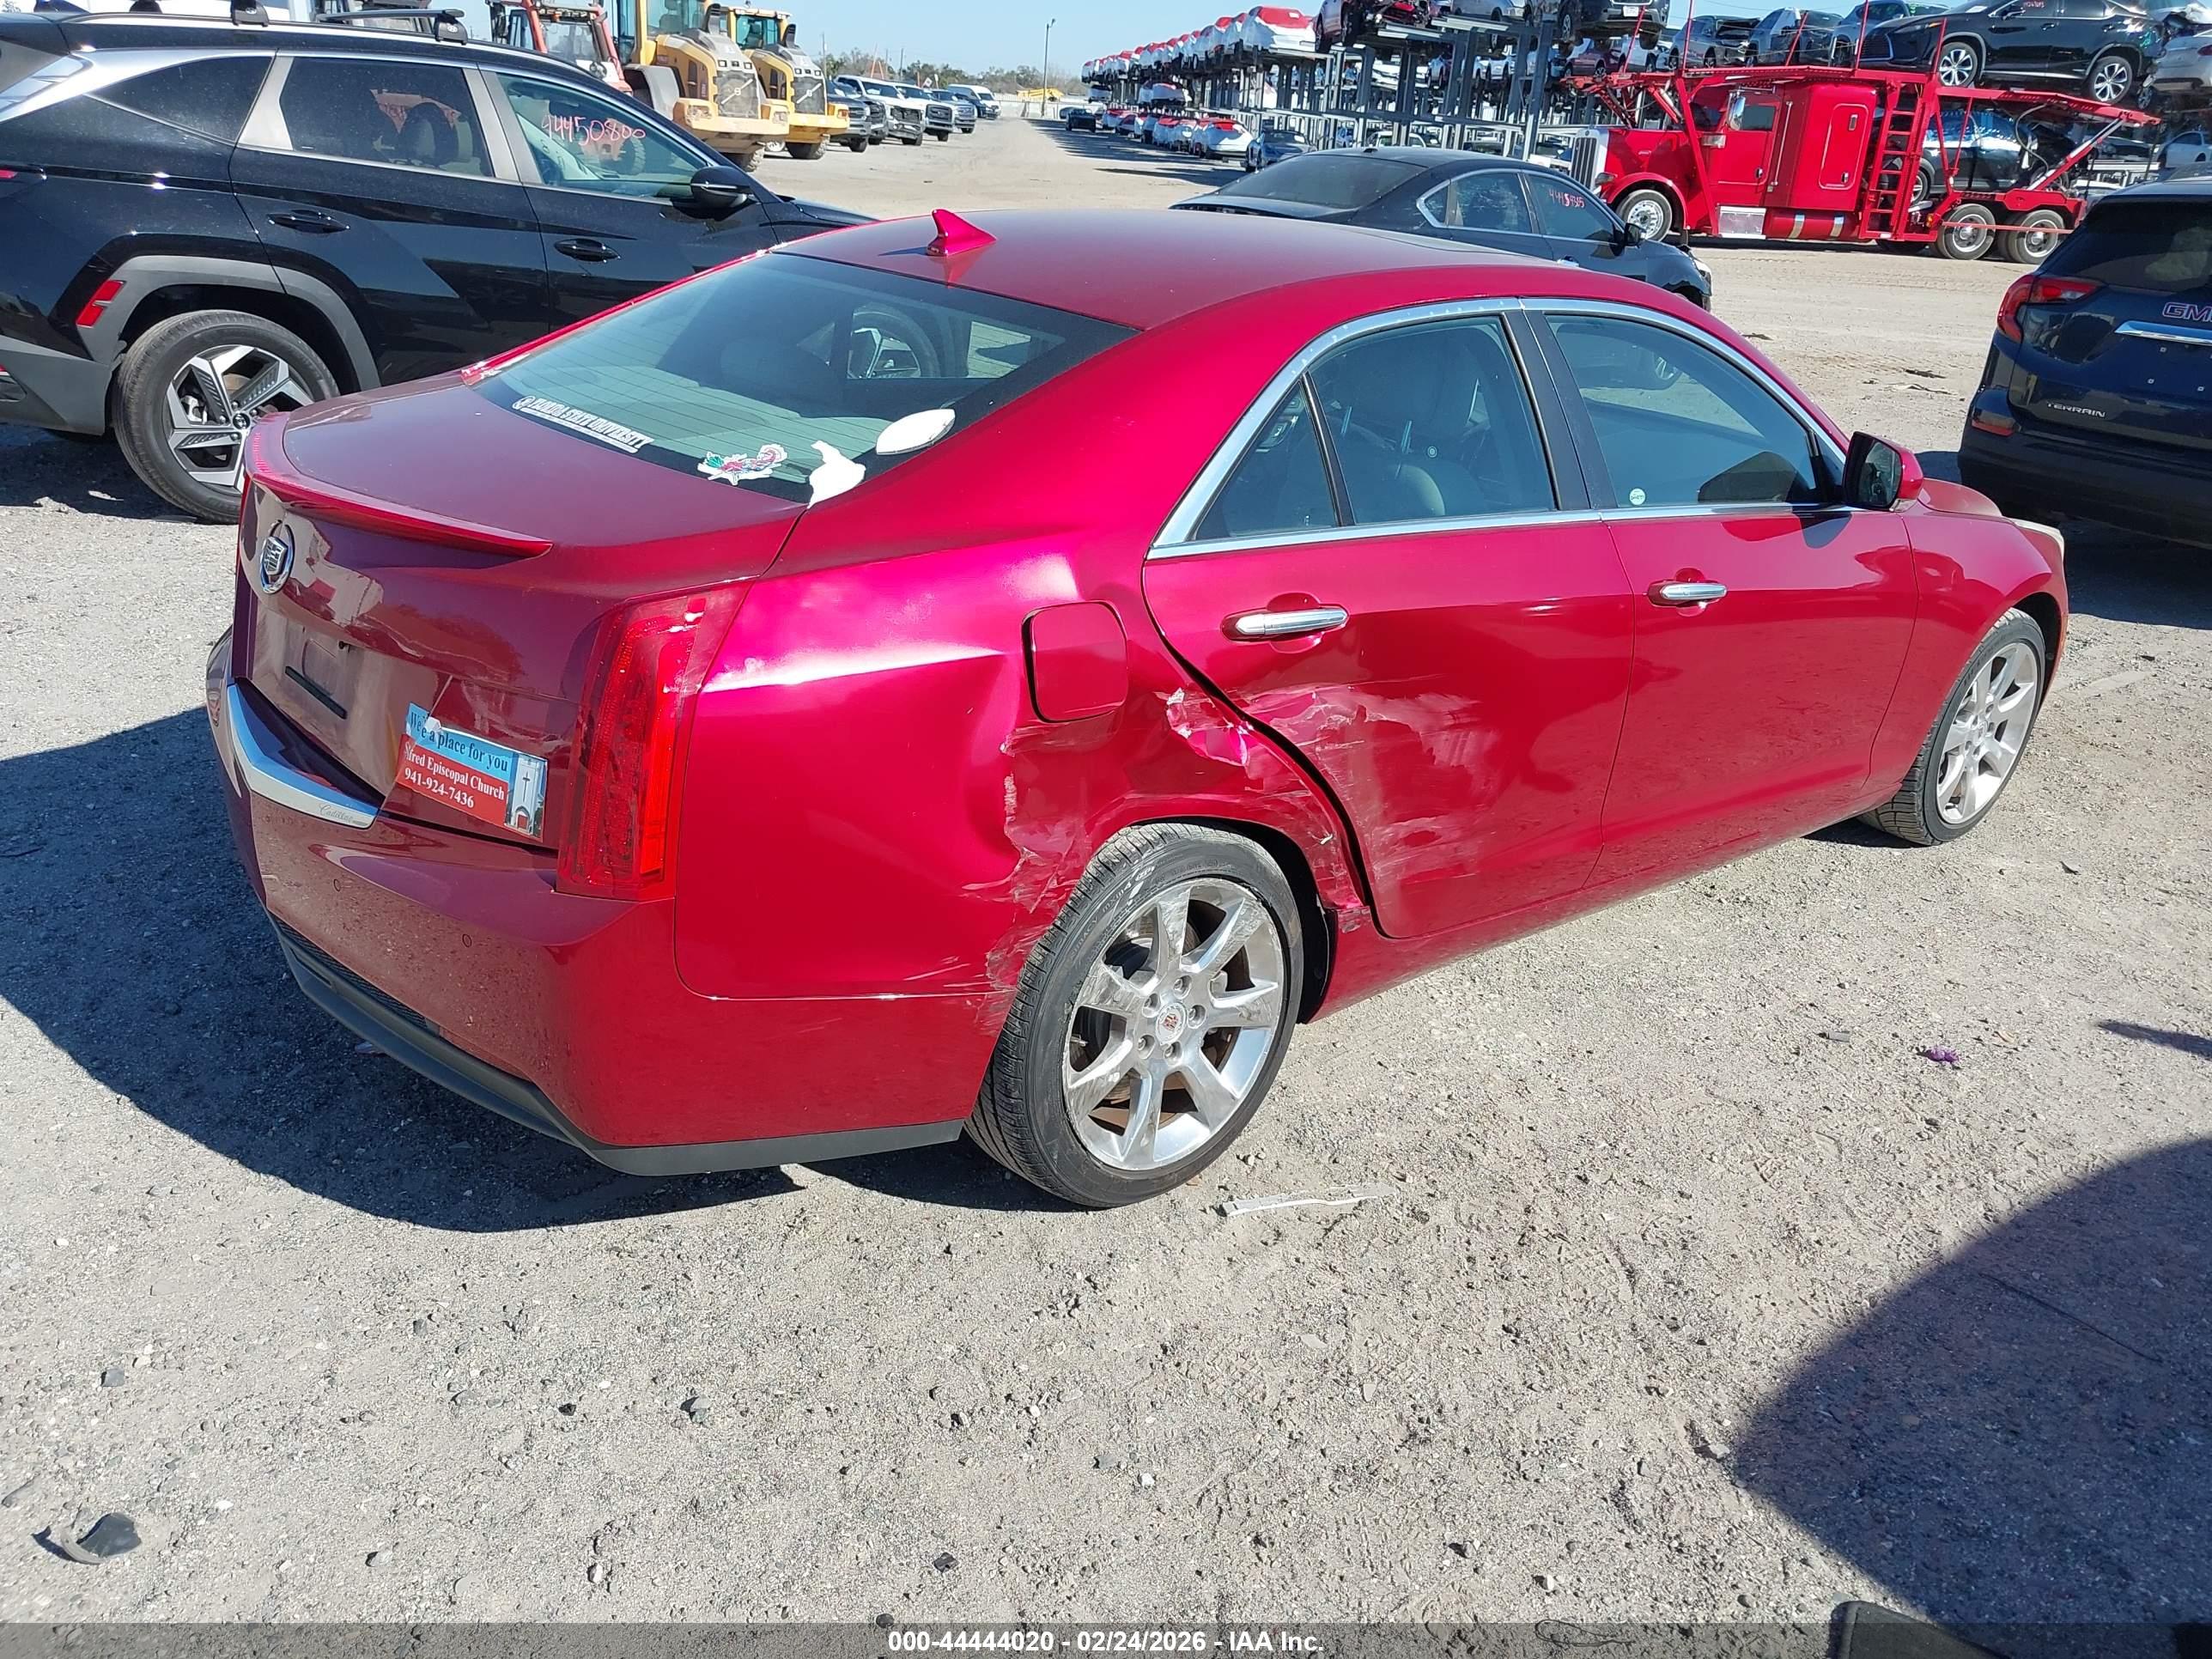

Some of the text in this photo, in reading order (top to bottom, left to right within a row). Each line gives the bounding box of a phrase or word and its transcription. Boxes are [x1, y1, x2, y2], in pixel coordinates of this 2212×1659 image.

[2162, 301, 2212, 323] GM
[2047, 401, 2106, 418] TERRAIN
[428, 730, 436, 743] a
[437, 732, 466, 755] place
[467, 741, 486, 763] for
[487, 753, 508, 772] you
[404, 767, 475, 808] 941-924-7436
[426, 757, 469, 786] Episcopal
[470, 775, 505, 801] Church
